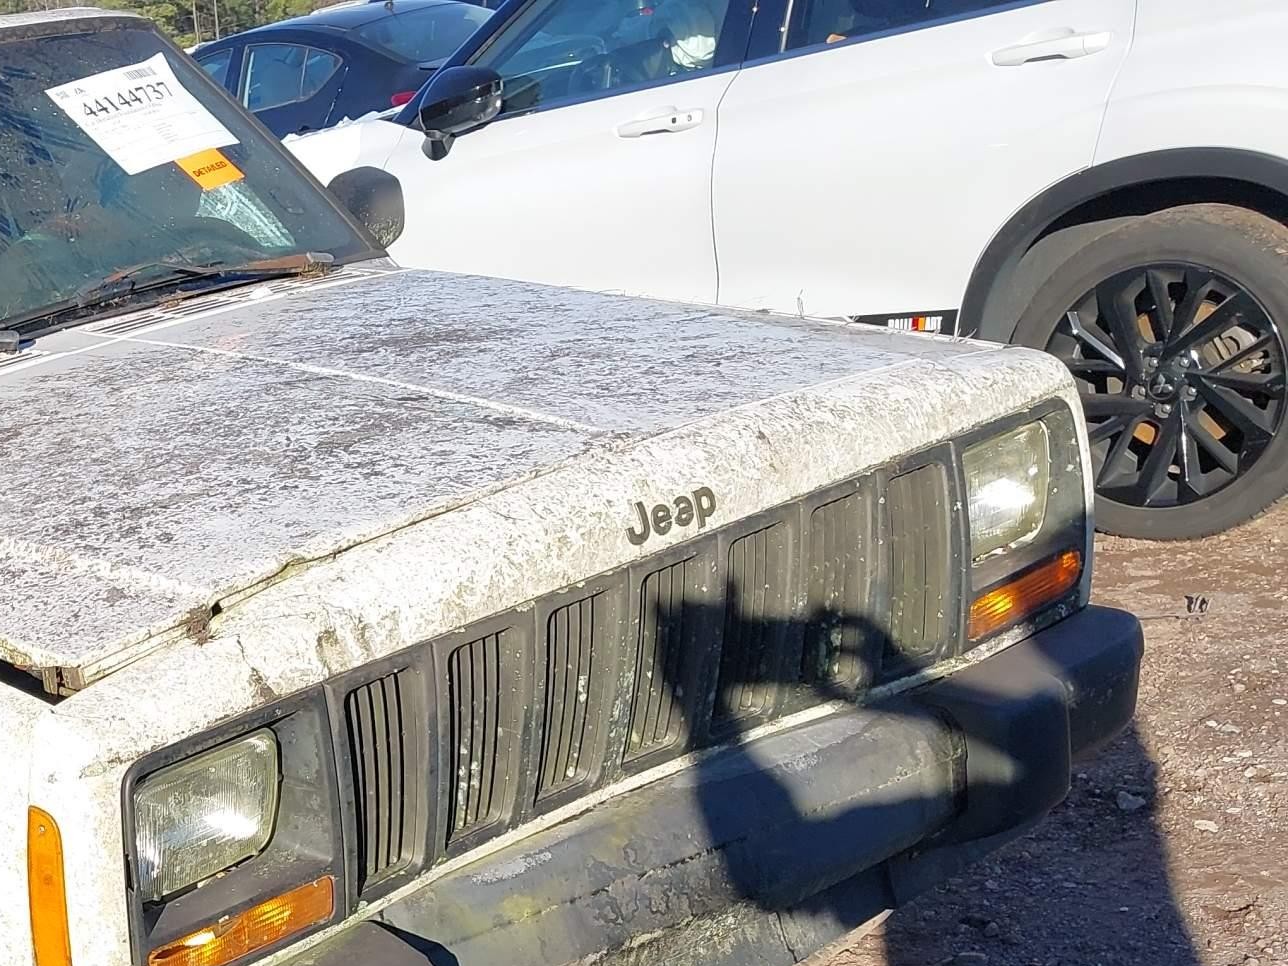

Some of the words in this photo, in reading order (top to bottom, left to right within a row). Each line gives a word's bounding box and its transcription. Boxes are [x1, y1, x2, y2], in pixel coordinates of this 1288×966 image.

[82, 82, 173, 117] 44144737
[192, 161, 228, 177] DETAILED
[625, 486, 717, 545] Jeep
